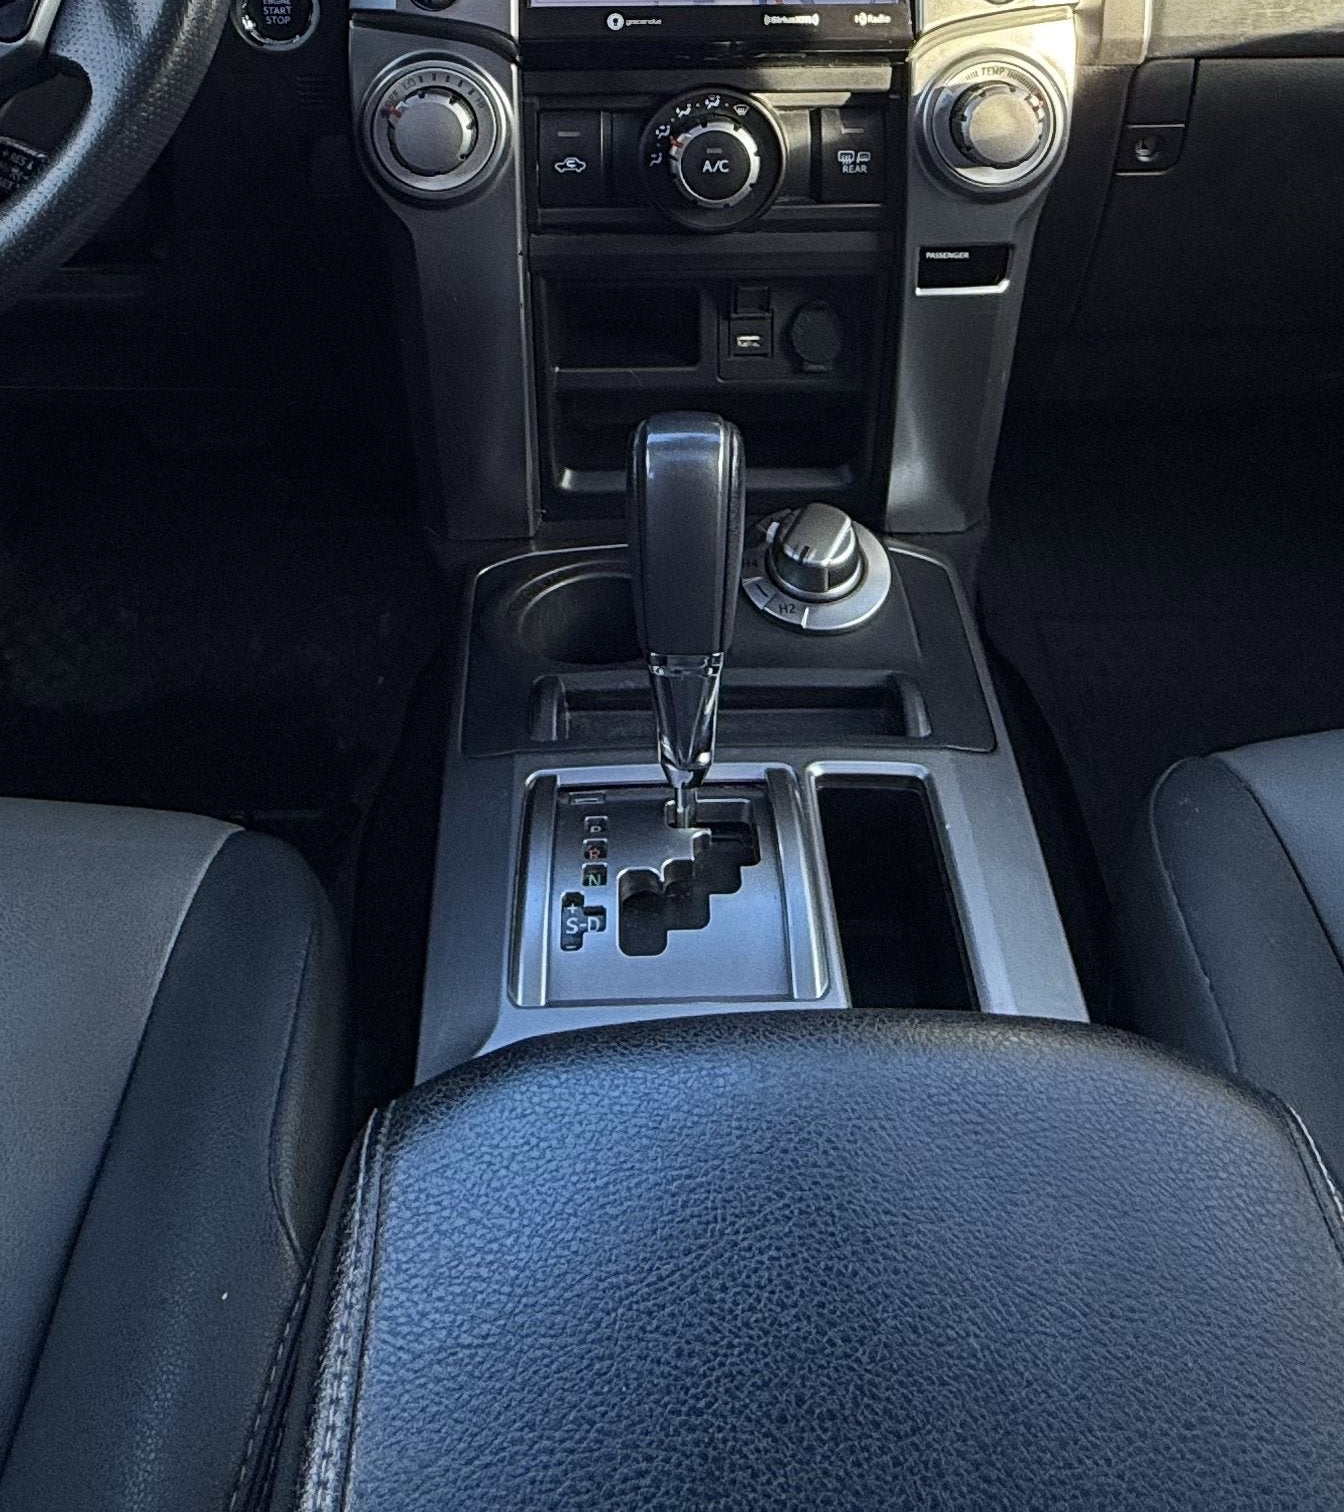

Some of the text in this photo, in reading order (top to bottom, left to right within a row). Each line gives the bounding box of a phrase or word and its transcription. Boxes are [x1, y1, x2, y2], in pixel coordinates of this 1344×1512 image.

[263, 6, 292, 15] START
[266, 15, 292, 25] STOP
[981, 66, 1005, 76] TEMP
[702, 159, 730, 174] A/C
[842, 164, 868, 174] REAR
[778, 603, 796, 615] H2
[588, 874, 601, 886] N
